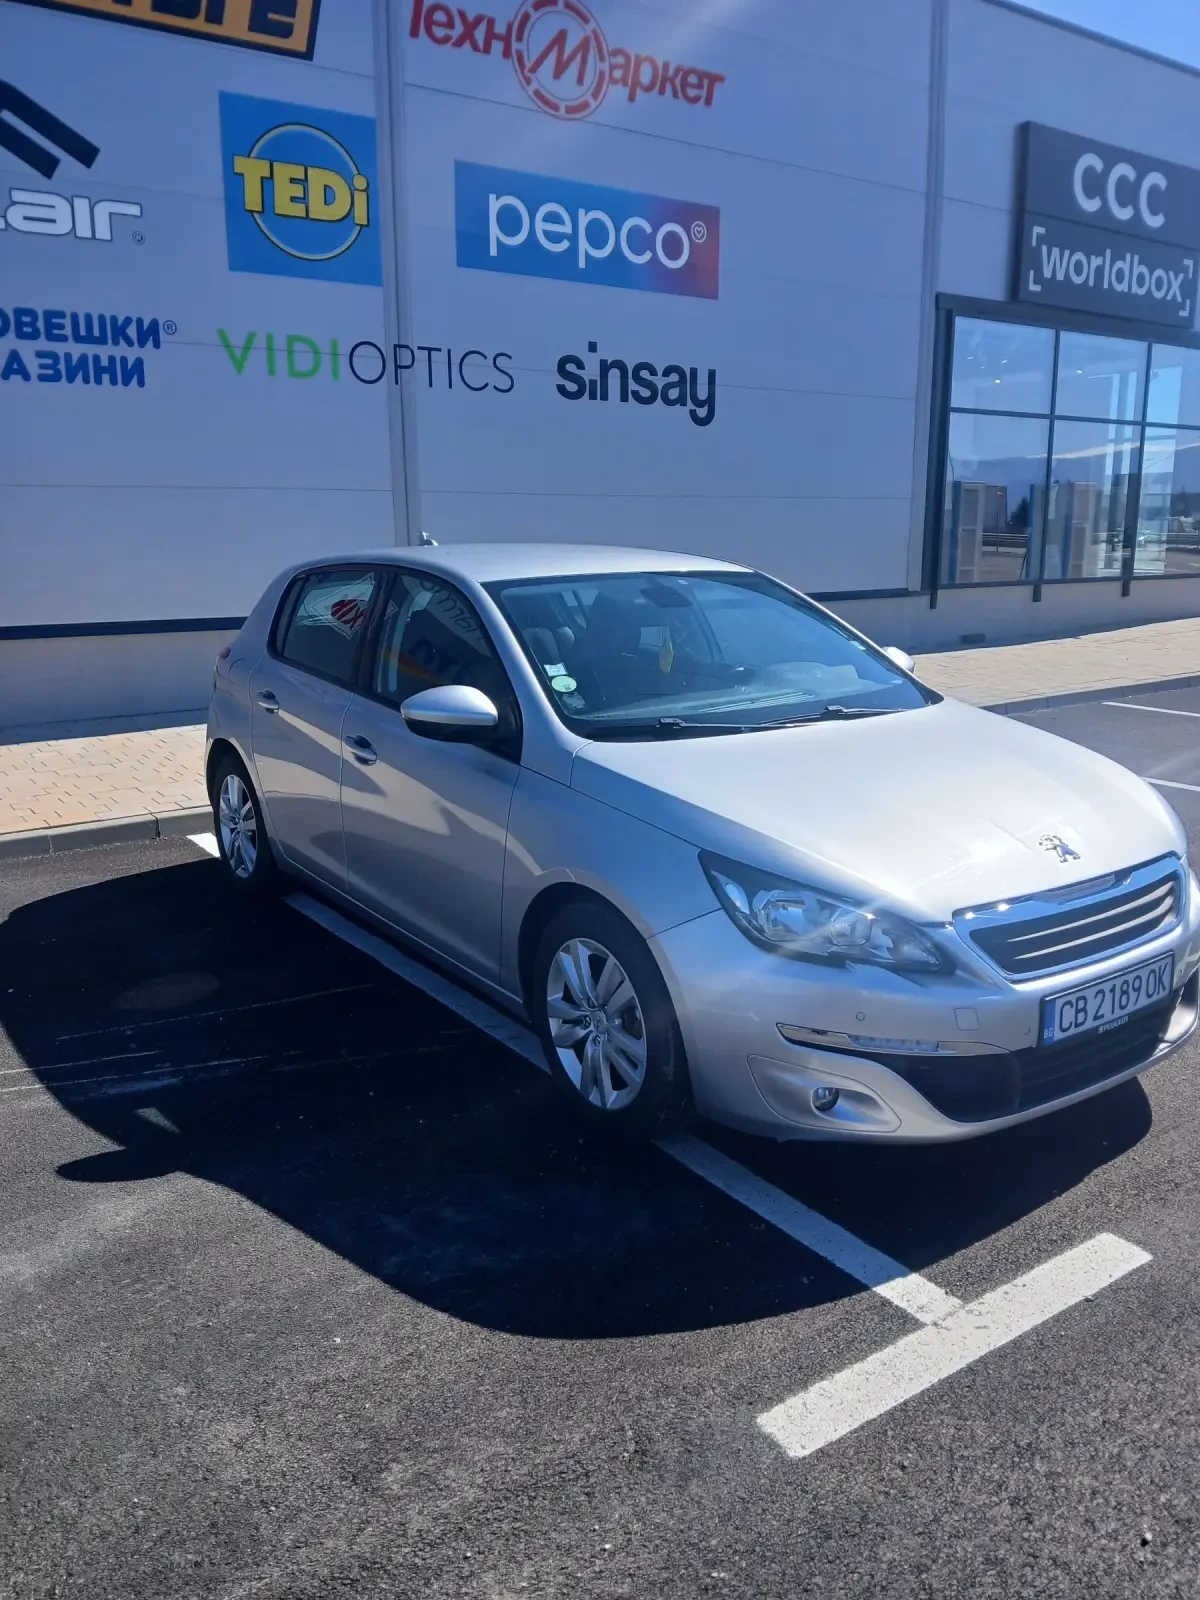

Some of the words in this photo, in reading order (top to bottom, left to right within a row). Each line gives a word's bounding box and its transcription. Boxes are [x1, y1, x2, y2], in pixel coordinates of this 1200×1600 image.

[0, 186, 143, 242] air
[232, 154, 370, 228] TEDi
[1073, 152, 1168, 229] CCC
[488, 192, 690, 269] pepco
[1040, 245, 1183, 303] worldbox
[556, 340, 717, 427] sinsay
[1092, 974, 1143, 1022] 2189
[1043, 1027, 1054, 1040] BG
